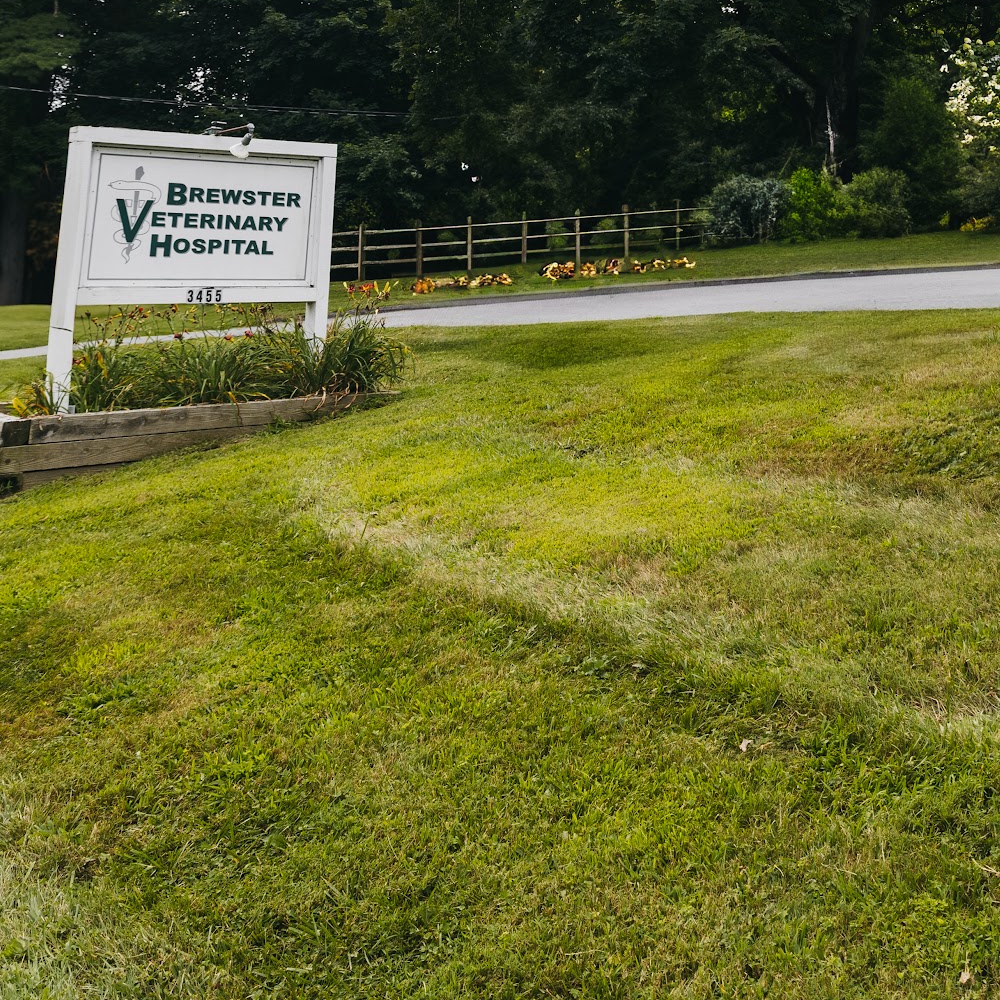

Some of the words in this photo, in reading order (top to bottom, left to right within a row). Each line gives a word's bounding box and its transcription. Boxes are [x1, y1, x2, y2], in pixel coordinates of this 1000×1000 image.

[167, 182, 301, 208] BREWSTER
[116, 198, 289, 243] VETERINARY
[149, 234, 274, 257] HOSPITAL
[187, 289, 222, 303] 3455
